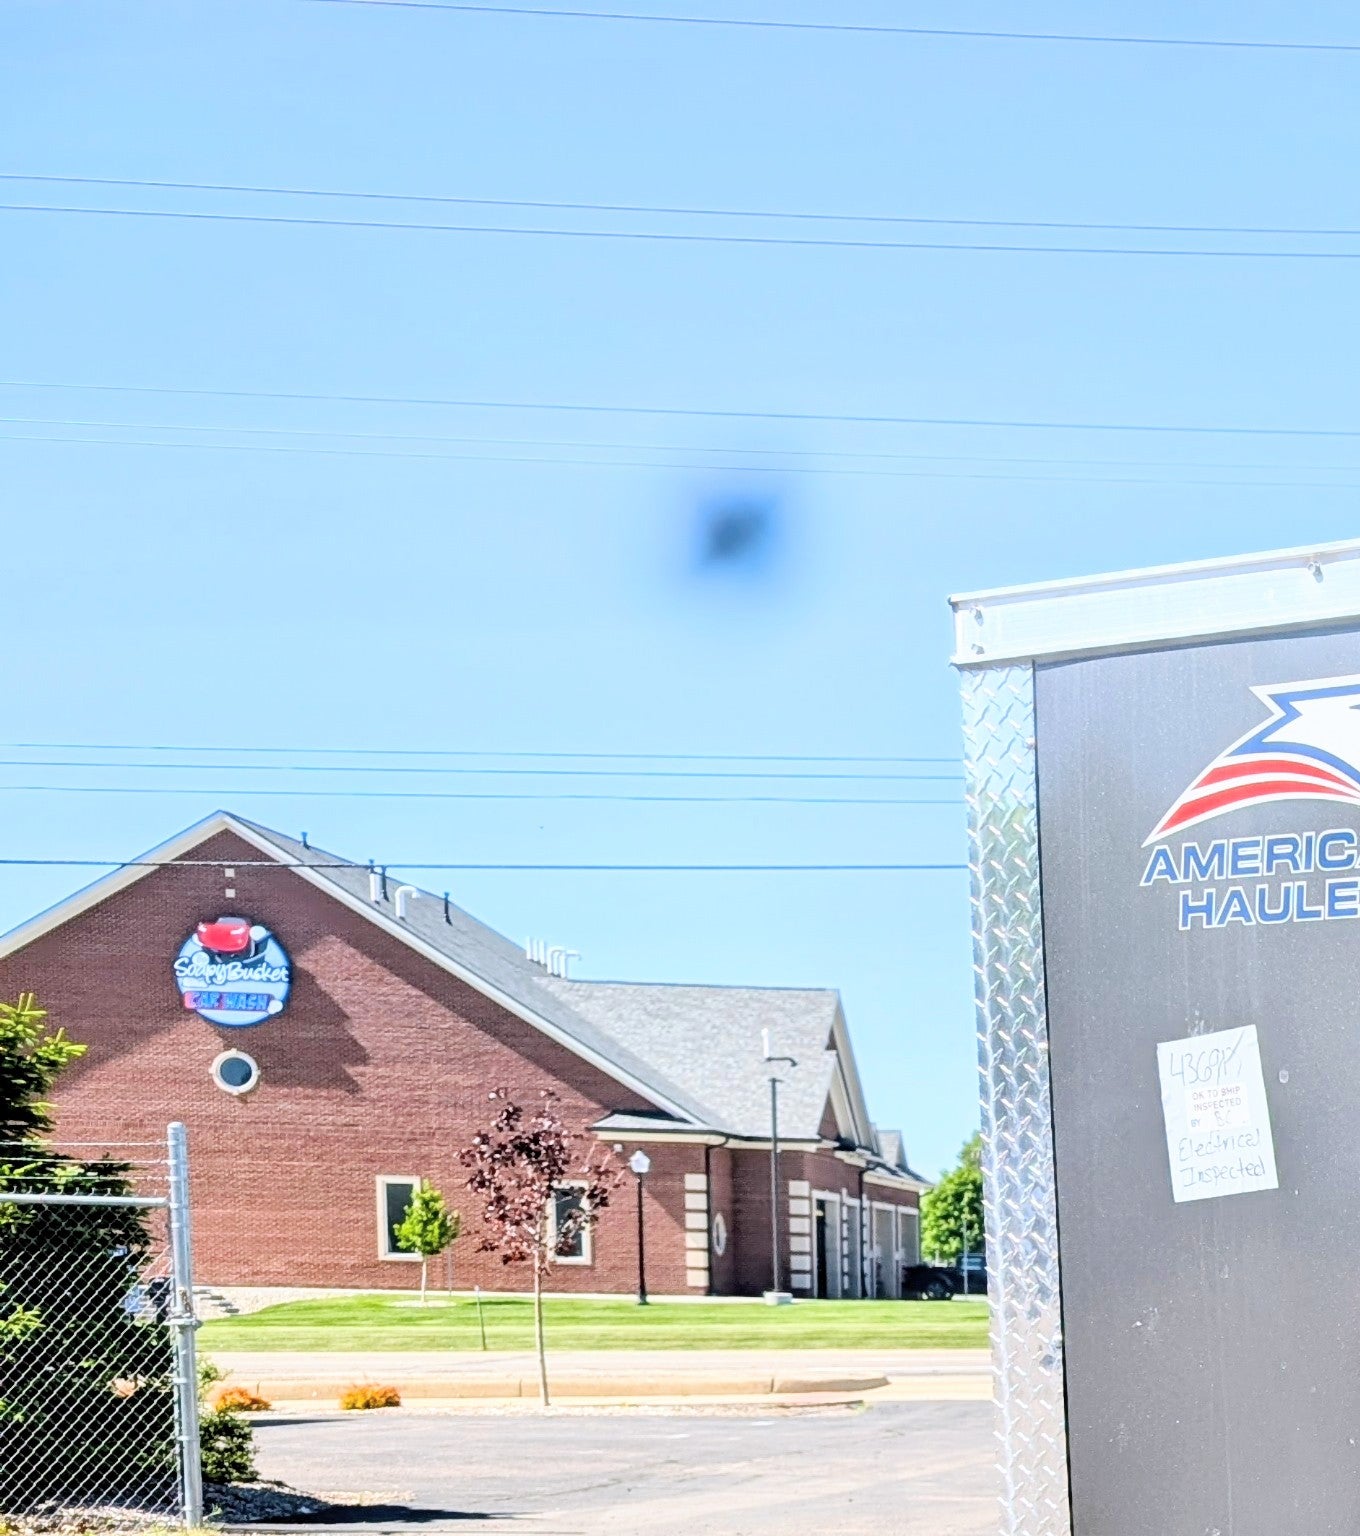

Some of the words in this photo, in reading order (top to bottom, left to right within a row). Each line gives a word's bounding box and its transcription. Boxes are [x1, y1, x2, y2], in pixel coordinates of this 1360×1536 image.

[191, 992, 221, 1009] CAR
[226, 993, 268, 1011] WASH
[1193, 1097, 1242, 1111] INSPECTED
[1180, 1155, 1265, 1187] Inspected
